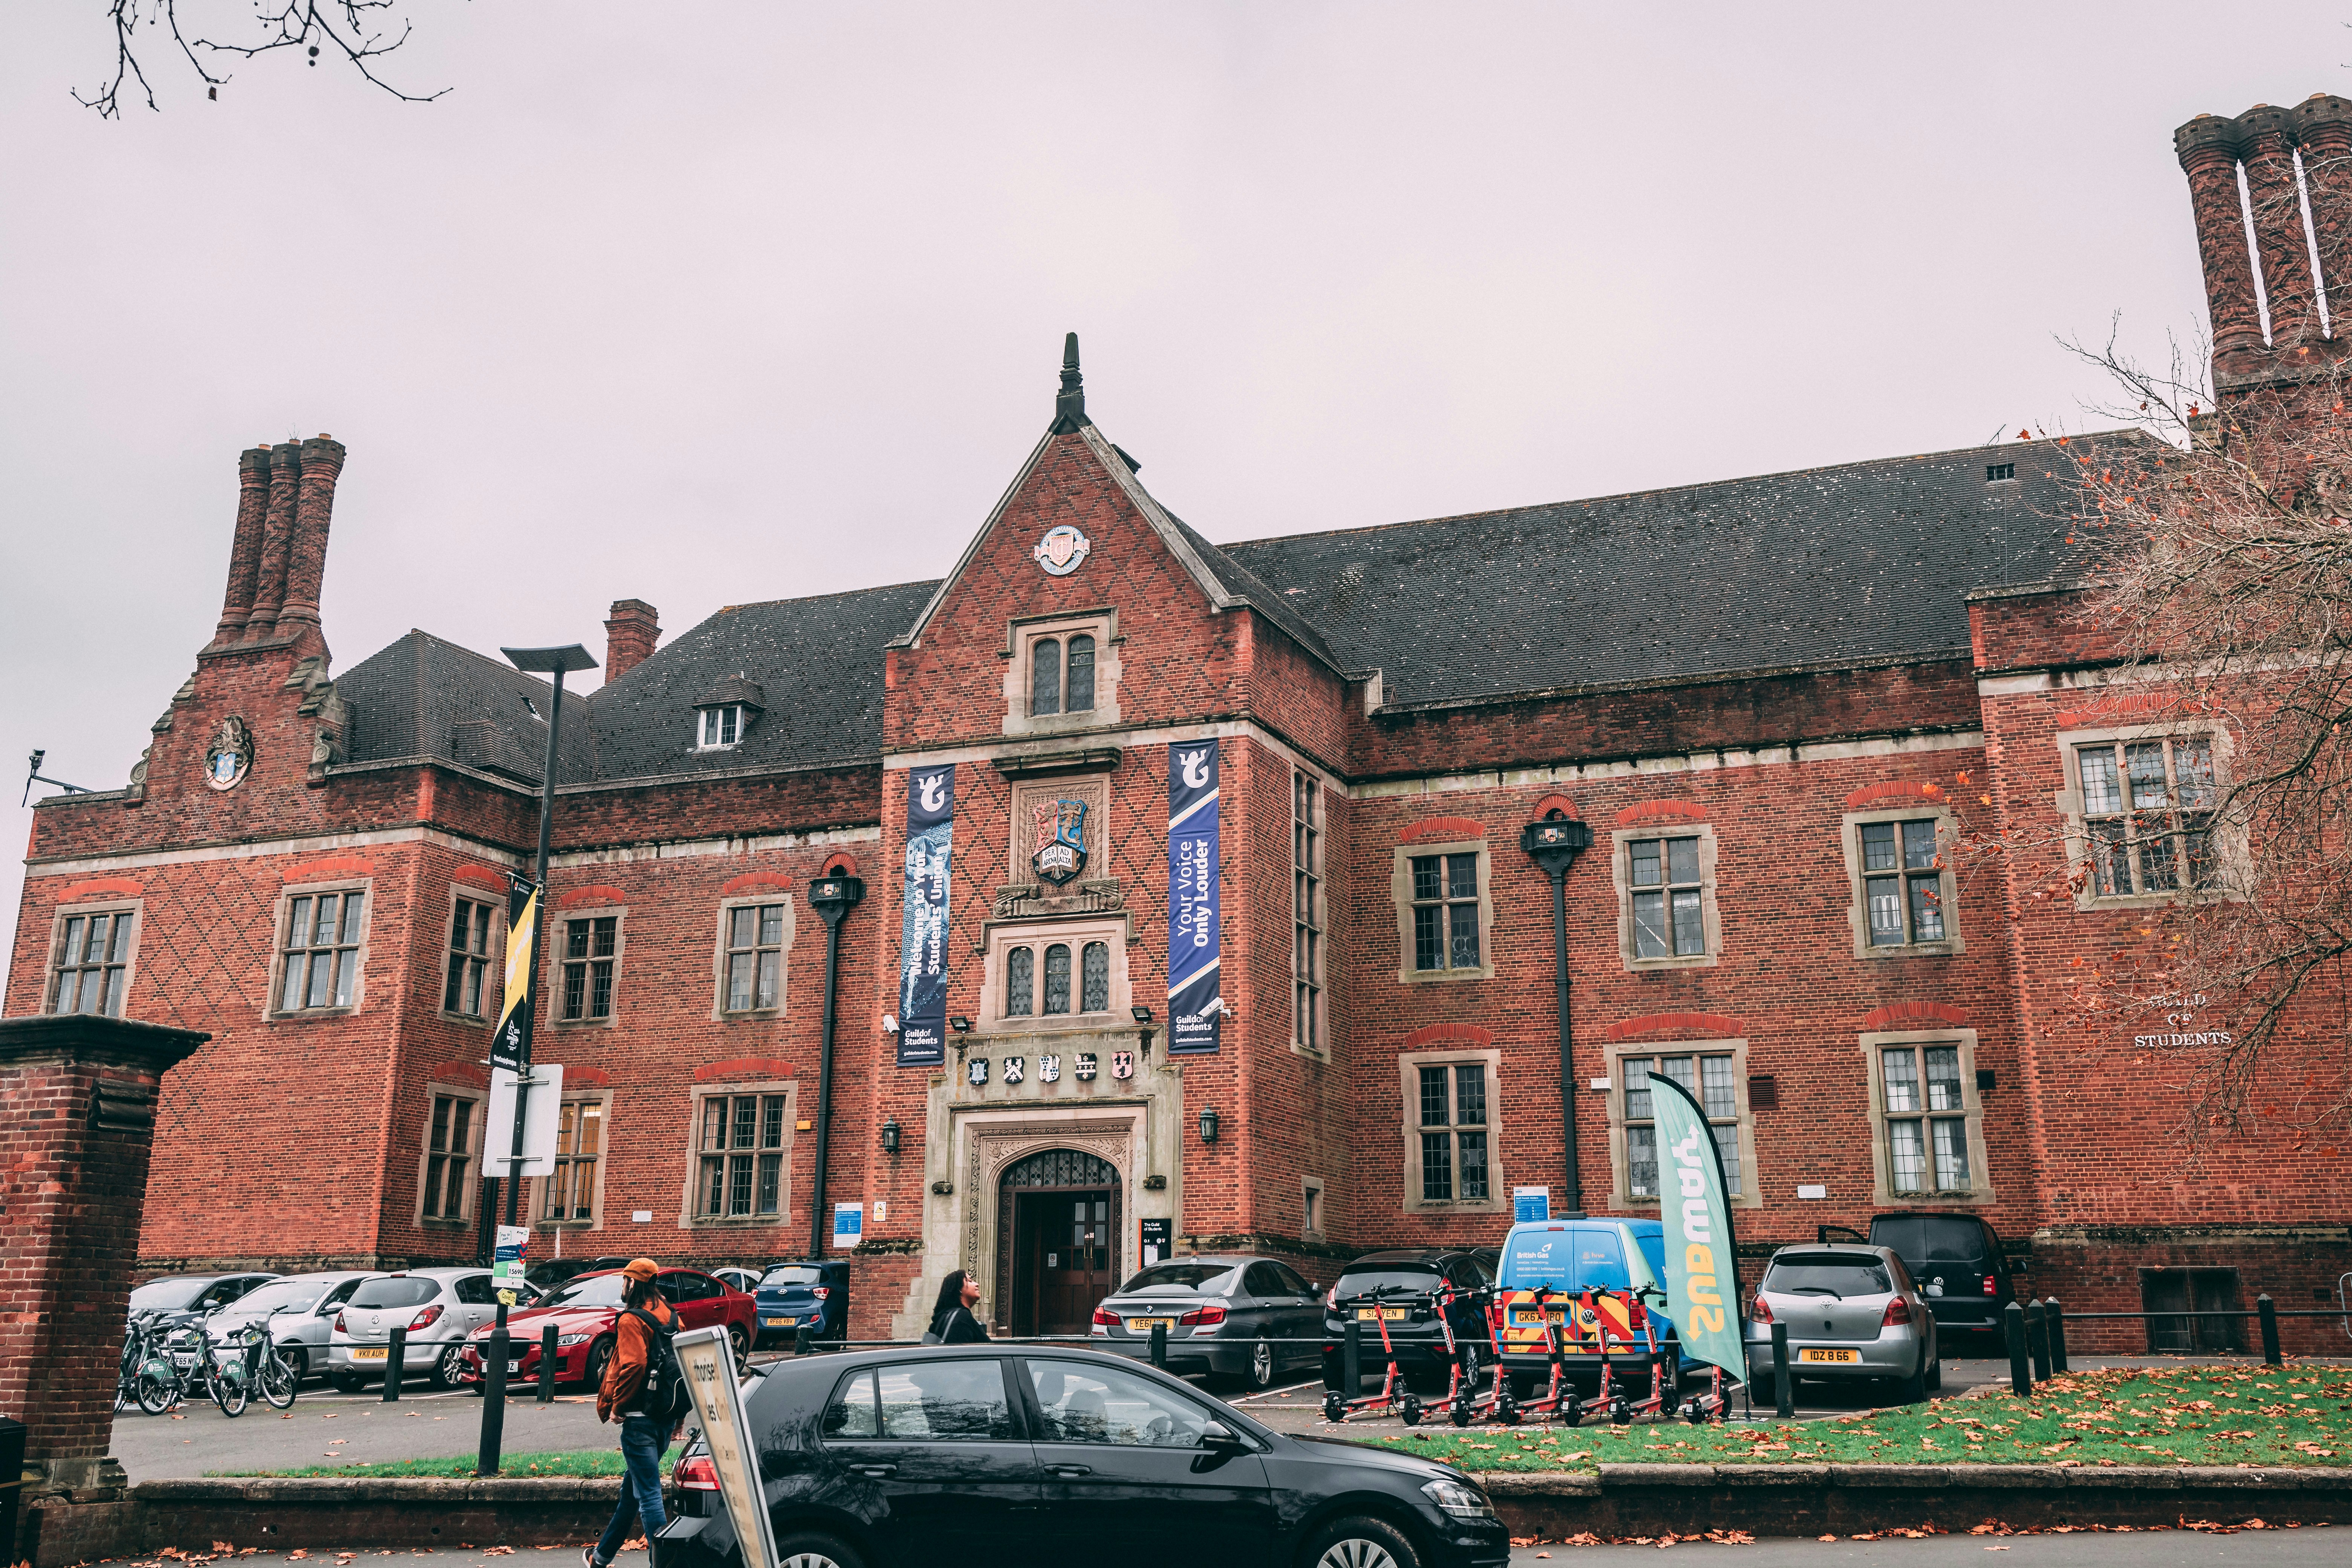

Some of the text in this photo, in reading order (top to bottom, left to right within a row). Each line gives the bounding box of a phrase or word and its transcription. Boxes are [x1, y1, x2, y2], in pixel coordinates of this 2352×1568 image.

[1055, 526, 1084, 542] CHAMBERLAIN
[1045, 848, 1055, 858] PER
[1058, 856, 1071, 865] ALTA
[1193, 839, 1208, 902] Louder
[929, 856, 943, 900] Union
[1176, 841, 1192, 937] Your Voice
[910, 851, 926, 976] Welcome to Your
[1176, 1023, 1212, 1032] Students
[905, 1037, 938, 1046] Students
[2135, 1032, 2231, 1047] STUDENTS
[502, 1293, 510, 1302] Covid
[1519, 1313, 1540, 1321] GK67
[1810, 1351, 1849, 1361] IDZ 8 66
